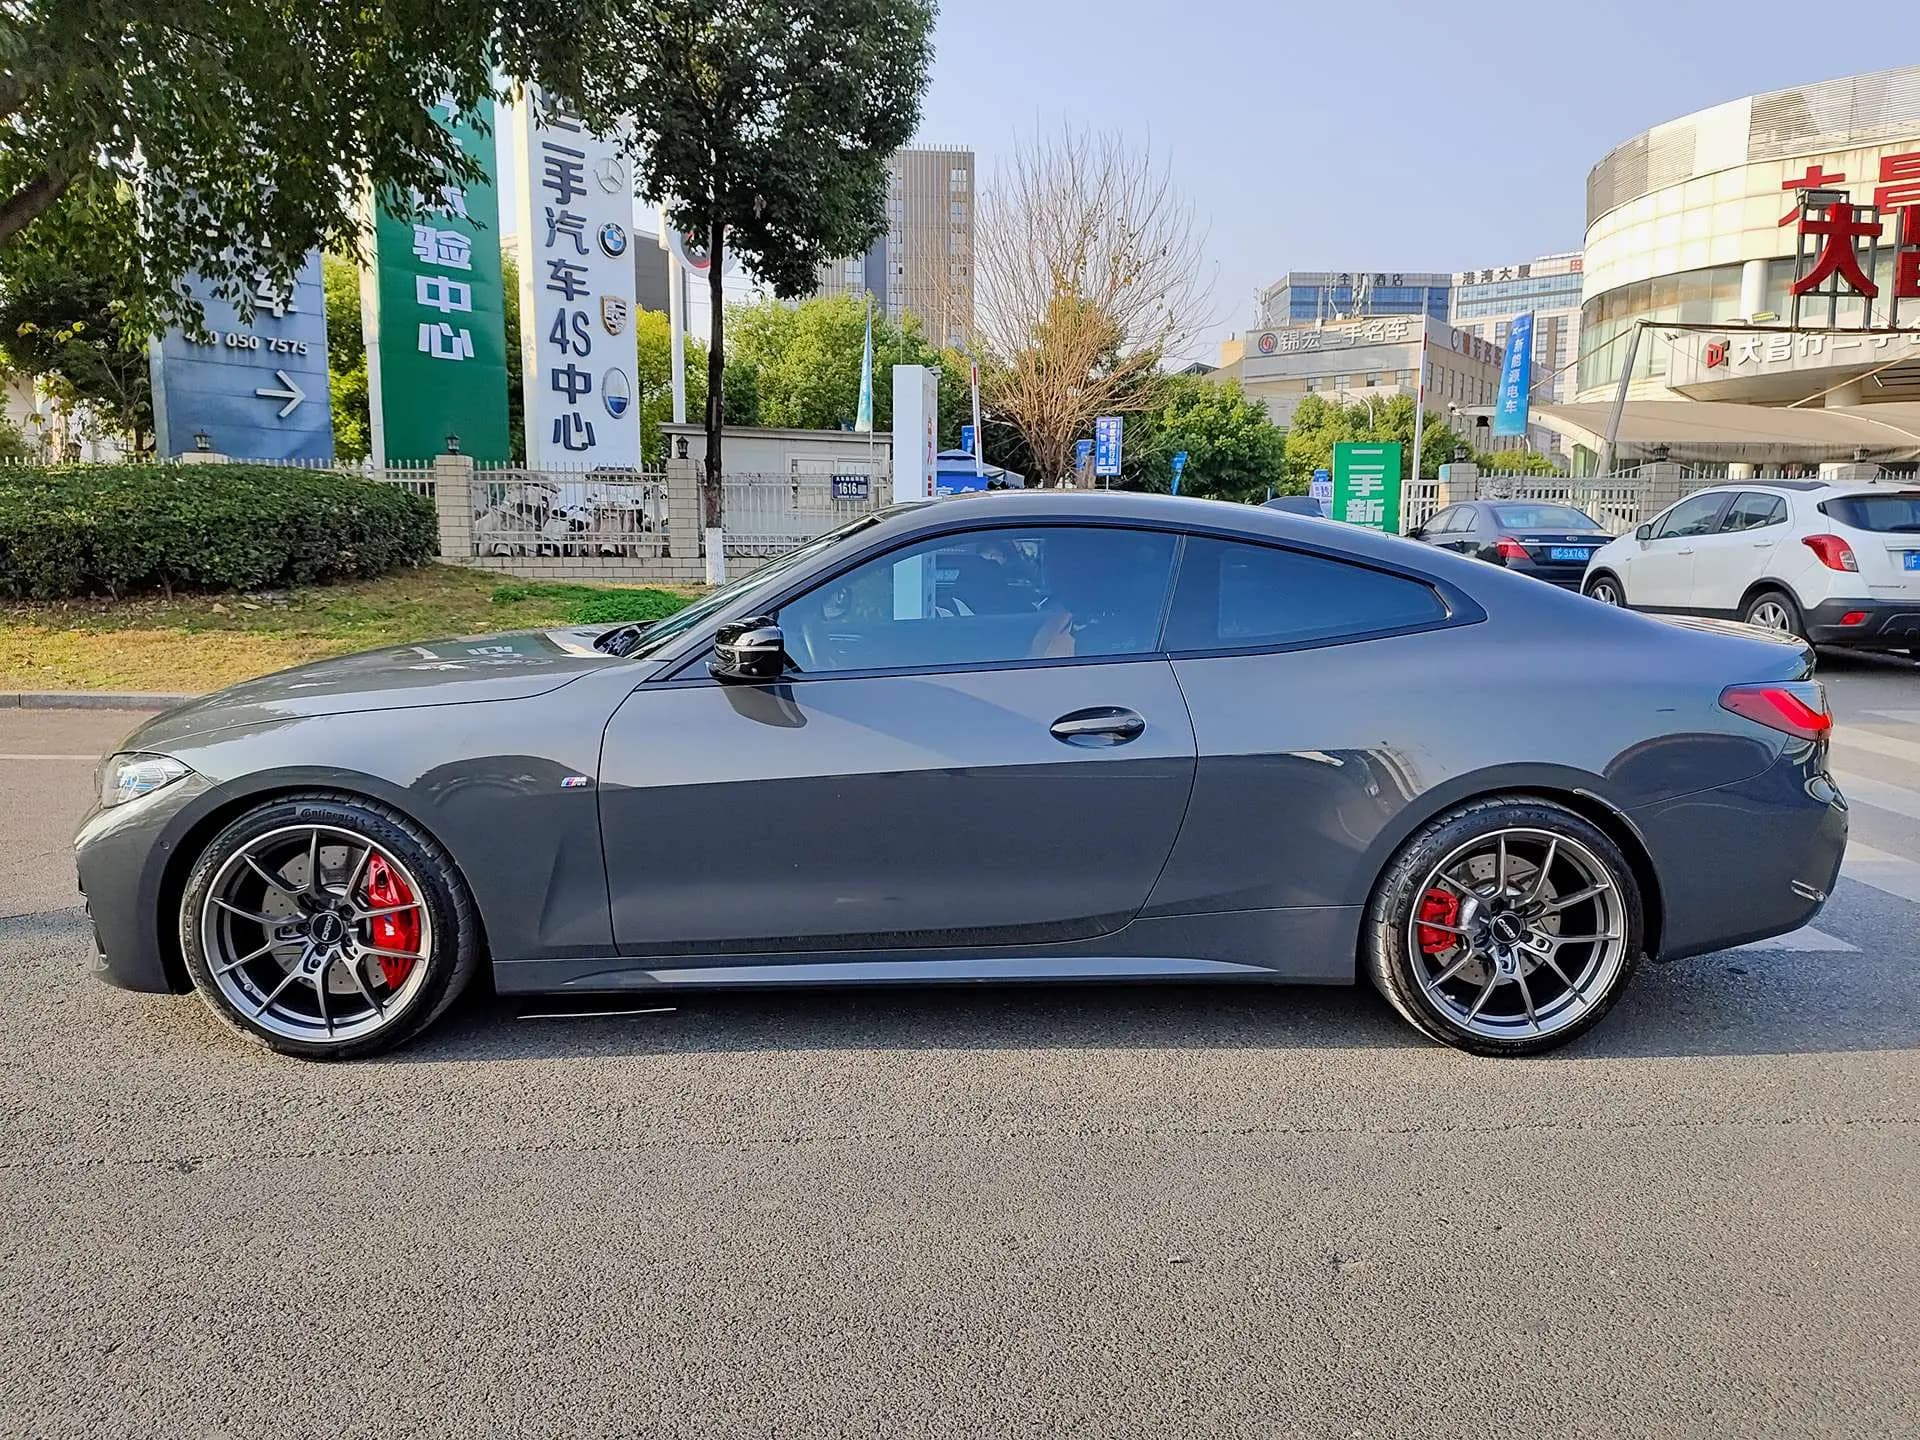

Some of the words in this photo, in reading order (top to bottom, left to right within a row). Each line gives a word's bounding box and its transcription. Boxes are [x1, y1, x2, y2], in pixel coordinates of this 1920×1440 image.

[1339, 273, 1404, 287] 全酒店
[1463, 263, 1531, 286] 港湾大厦
[226, 333, 260, 350] 050
[267, 337, 309, 356] 7575
[1280, 317, 1410, 351] 锦宏二手名车
[1503, 337, 1525, 414] 新能源电车
[839, 482, 857, 495] 1616
[1346, 449, 1384, 530] 二手新
[300, 808, 359, 825] Continental
